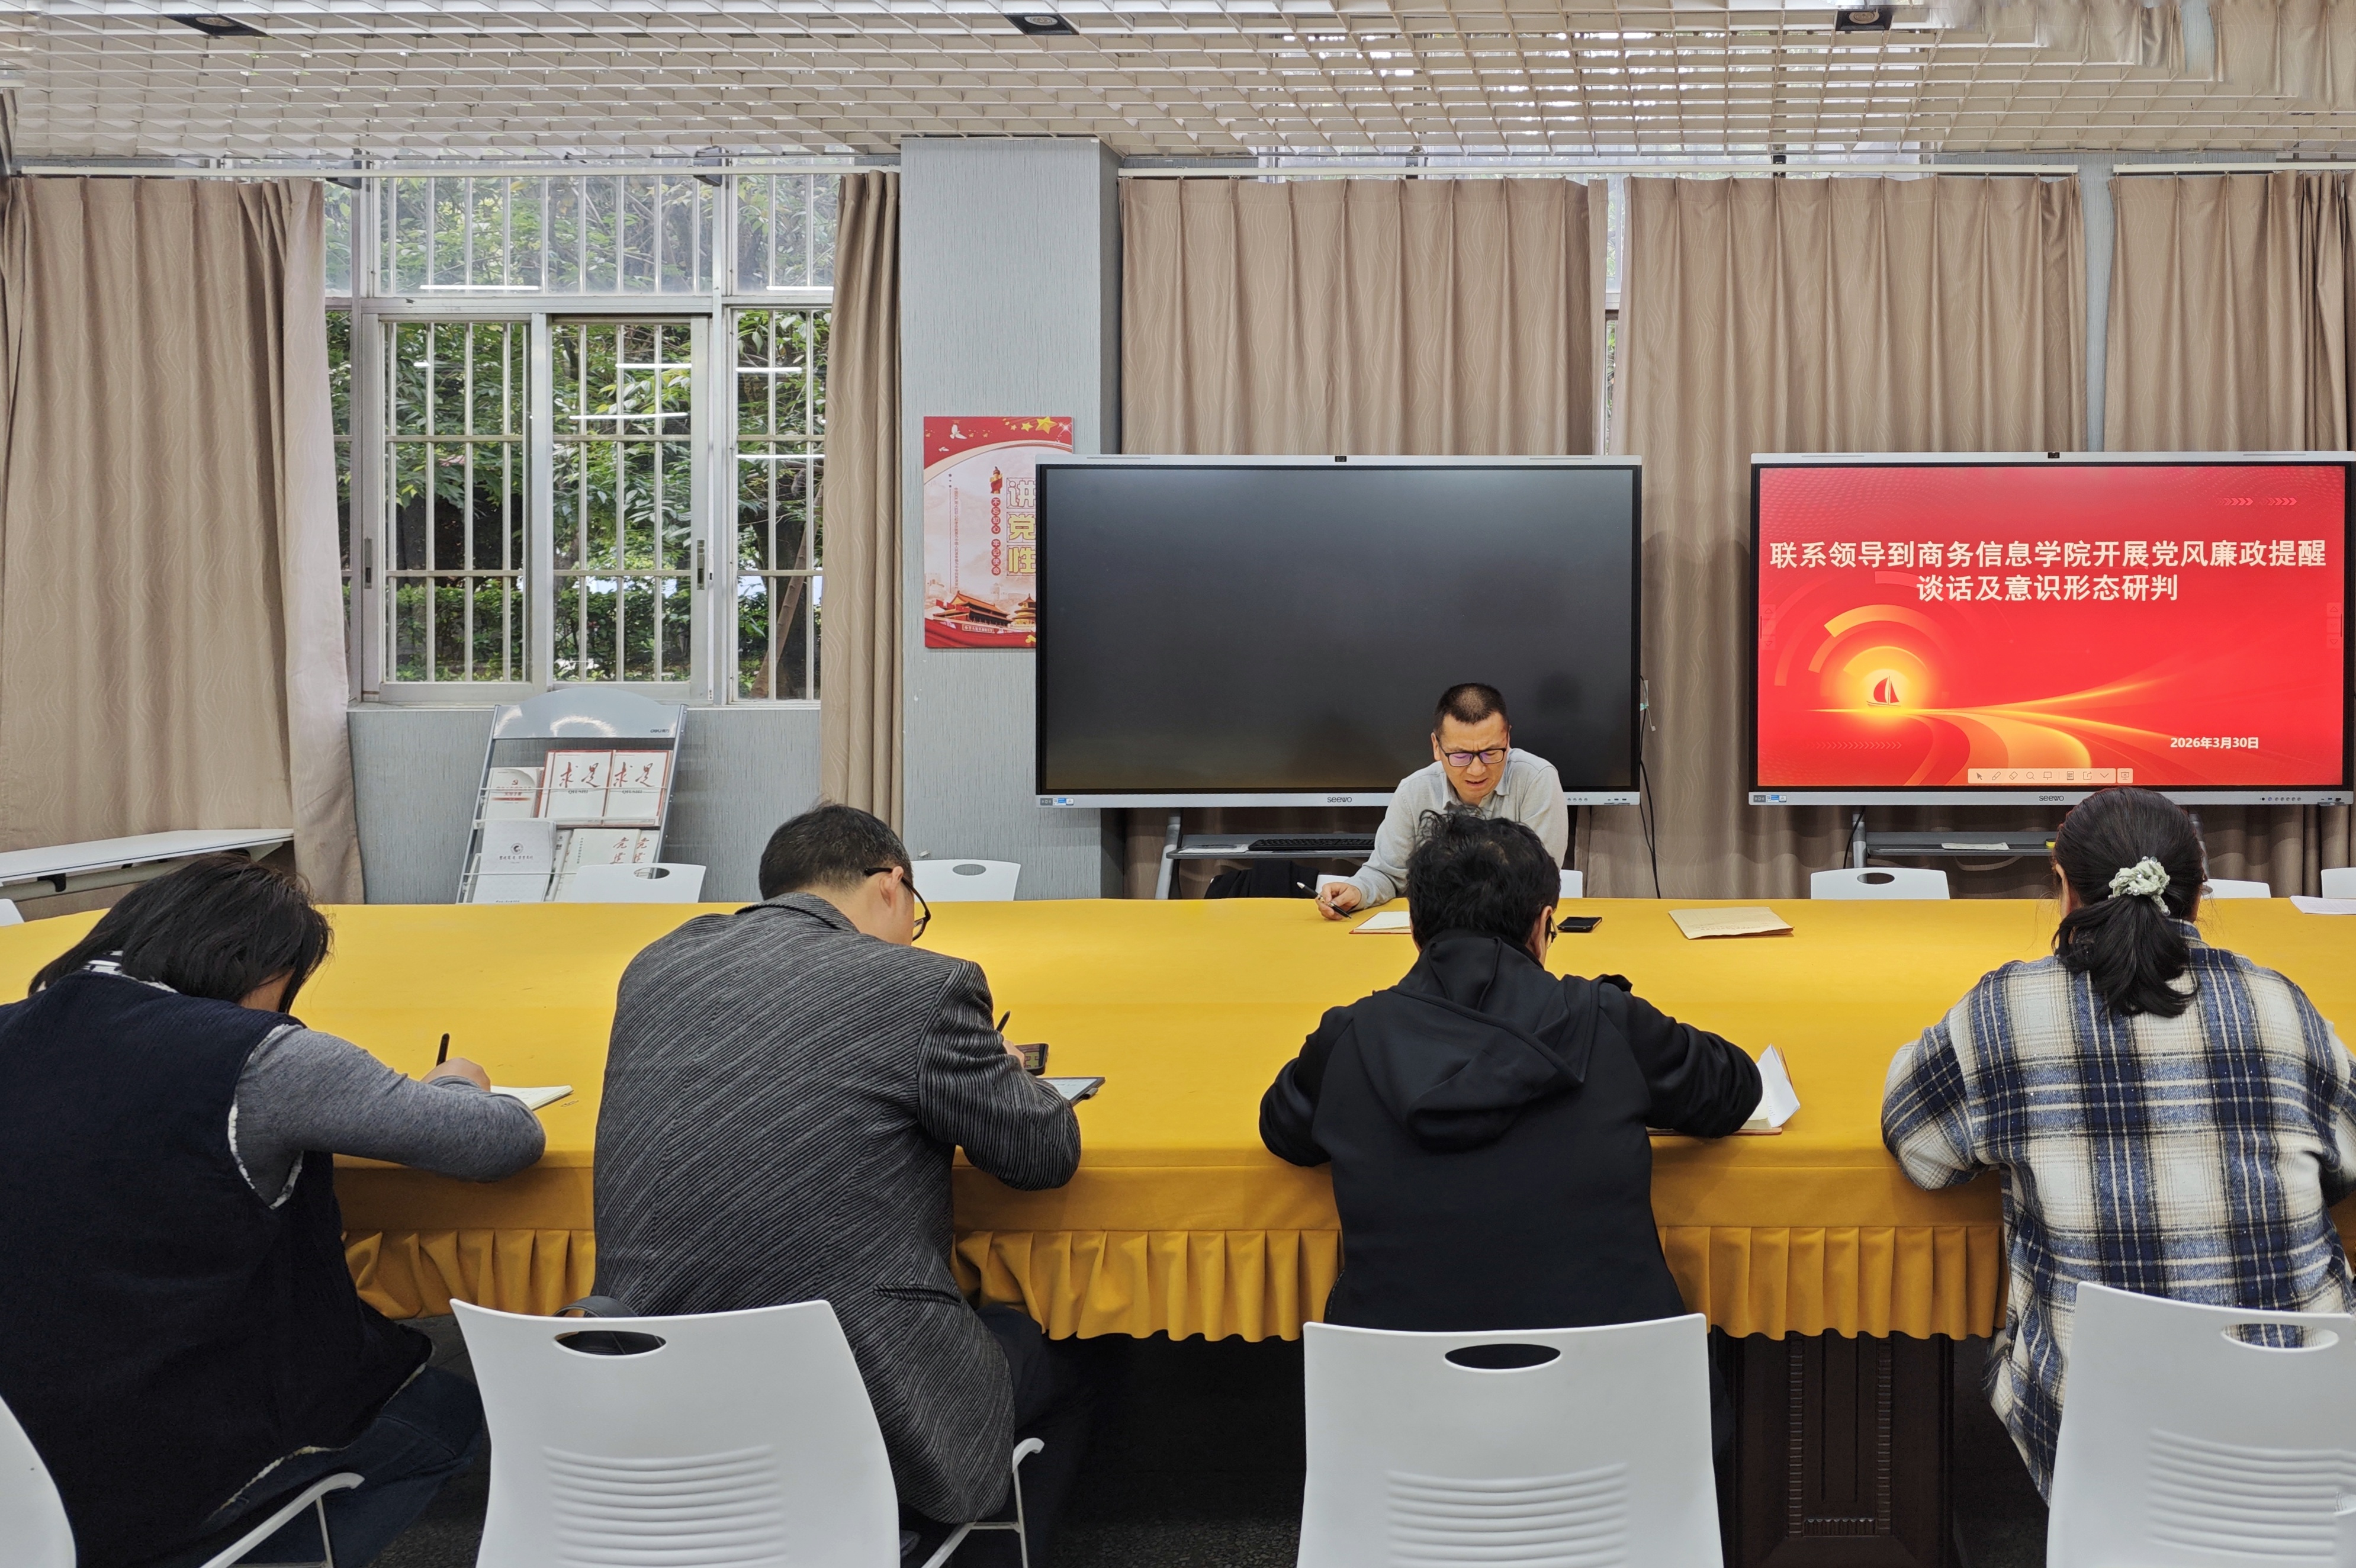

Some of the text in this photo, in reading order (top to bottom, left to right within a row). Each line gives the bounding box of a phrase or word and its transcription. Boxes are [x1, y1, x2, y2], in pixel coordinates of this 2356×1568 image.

[991, 497, 1001, 576] 不忘初心 牢记使命
[1008, 480, 1036, 574] 讲党性
[1770, 539, 2326, 569] 联系领导到商务信息学院开展党风廉政提醒
[1917, 574, 2178, 602] 谈话及意识形态研判
[2170, 737, 2259, 749] 2026年3月30日
[559, 761, 600, 788] 求是
[613, 761, 655, 788] 求是
